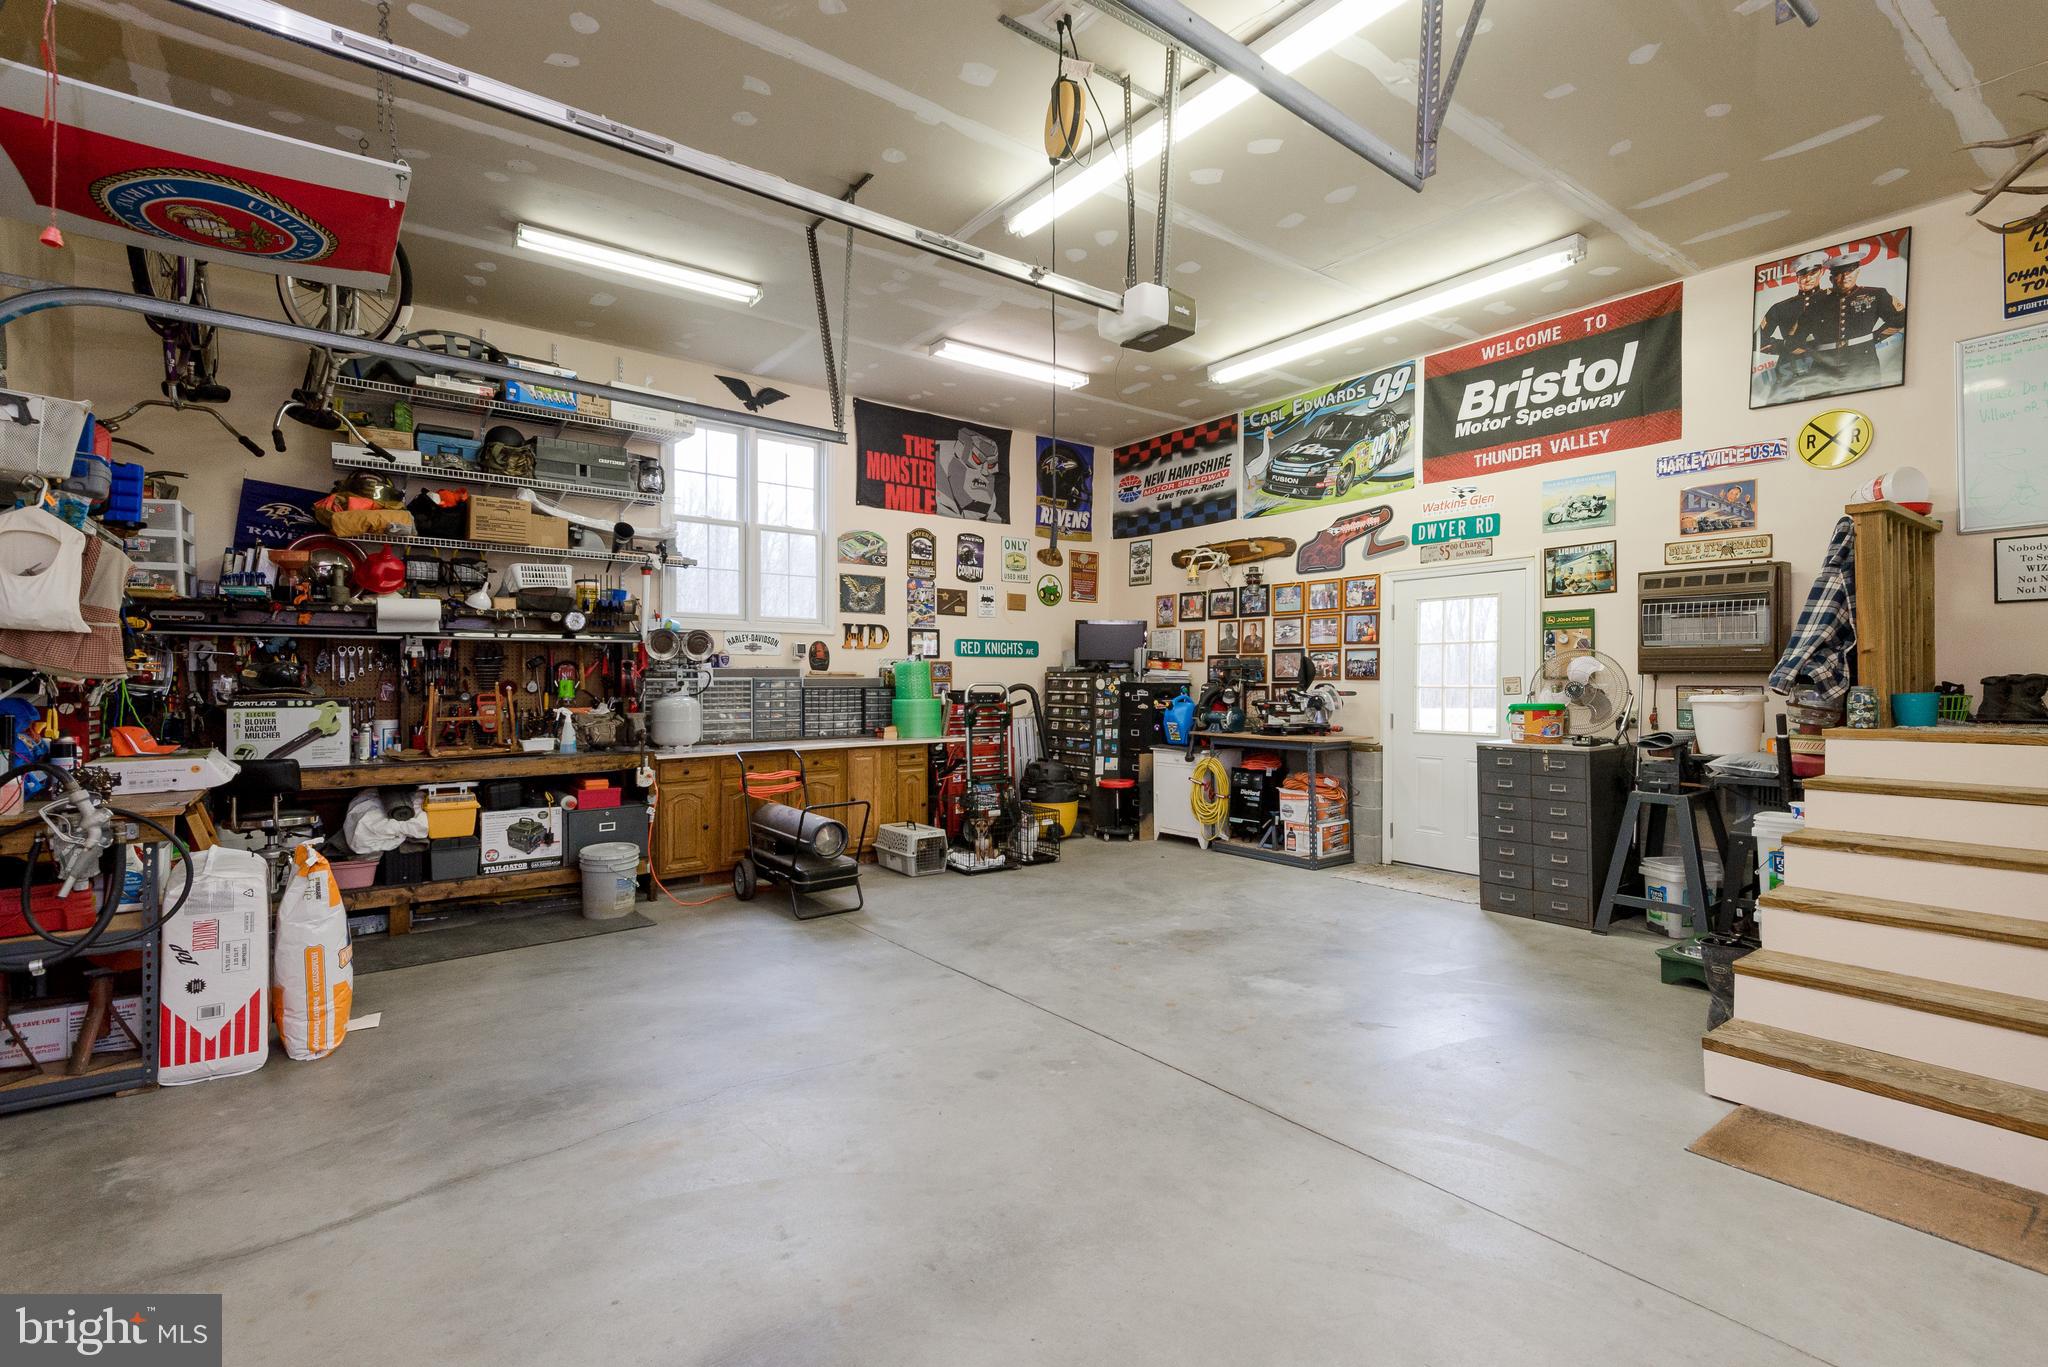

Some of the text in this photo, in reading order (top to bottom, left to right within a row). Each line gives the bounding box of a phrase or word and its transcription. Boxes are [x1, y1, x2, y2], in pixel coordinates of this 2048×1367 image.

[115, 183, 179, 208] MARINE
[247, 201, 317, 241] UNITED
[1481, 313, 1607, 360] WELCOME TO
[1457, 341, 1639, 421] Bristol
[1250, 366, 1412, 427] CARL EDWARDS 99
[1455, 390, 1626, 438] Motor Speedway
[902, 434, 936, 460] THE
[1806, 435, 1816, 450] R
[1852, 428, 1862, 443] R
[1474, 429, 1611, 468] THUNDER VALLEY
[866, 450, 936, 489] MONSTER
[1144, 453, 1232, 488] NEW HAMPSHIRE
[1271, 475, 1299, 485] FUSION
[1143, 471, 1228, 496] MOTOR SPEEDWAY
[1156, 491, 1174, 501] Live
[1175, 487, 1193, 497] Free
[1200, 480, 1225, 492] Race!
[885, 482, 937, 515] MILE
[1422, 499, 1467, 513] Watkins
[1470, 495, 1495, 506] Glen
[1688, 493, 1748, 519] LIONEL
[1418, 516, 1494, 541] DWYER RD
[1004, 539, 1028, 551] ONLY
[1459, 539, 1486, 551] Charge
[2020, 554, 2033, 562] To
[2016, 586, 2036, 594] Not
[2018, 575, 2037, 583] Not
[726, 634, 780, 647] HARLEY-DAVIDSON
[842, 623, 890, 649] HD
[961, 641, 980, 655] RED
[984, 641, 1023, 655] KNIGHTS
[233, 712, 240, 723] 3
[484, 862, 528, 874] TAILGATOR
[192, 918, 218, 952] BEDDING
[41, 1017, 60, 1025] LIVES
